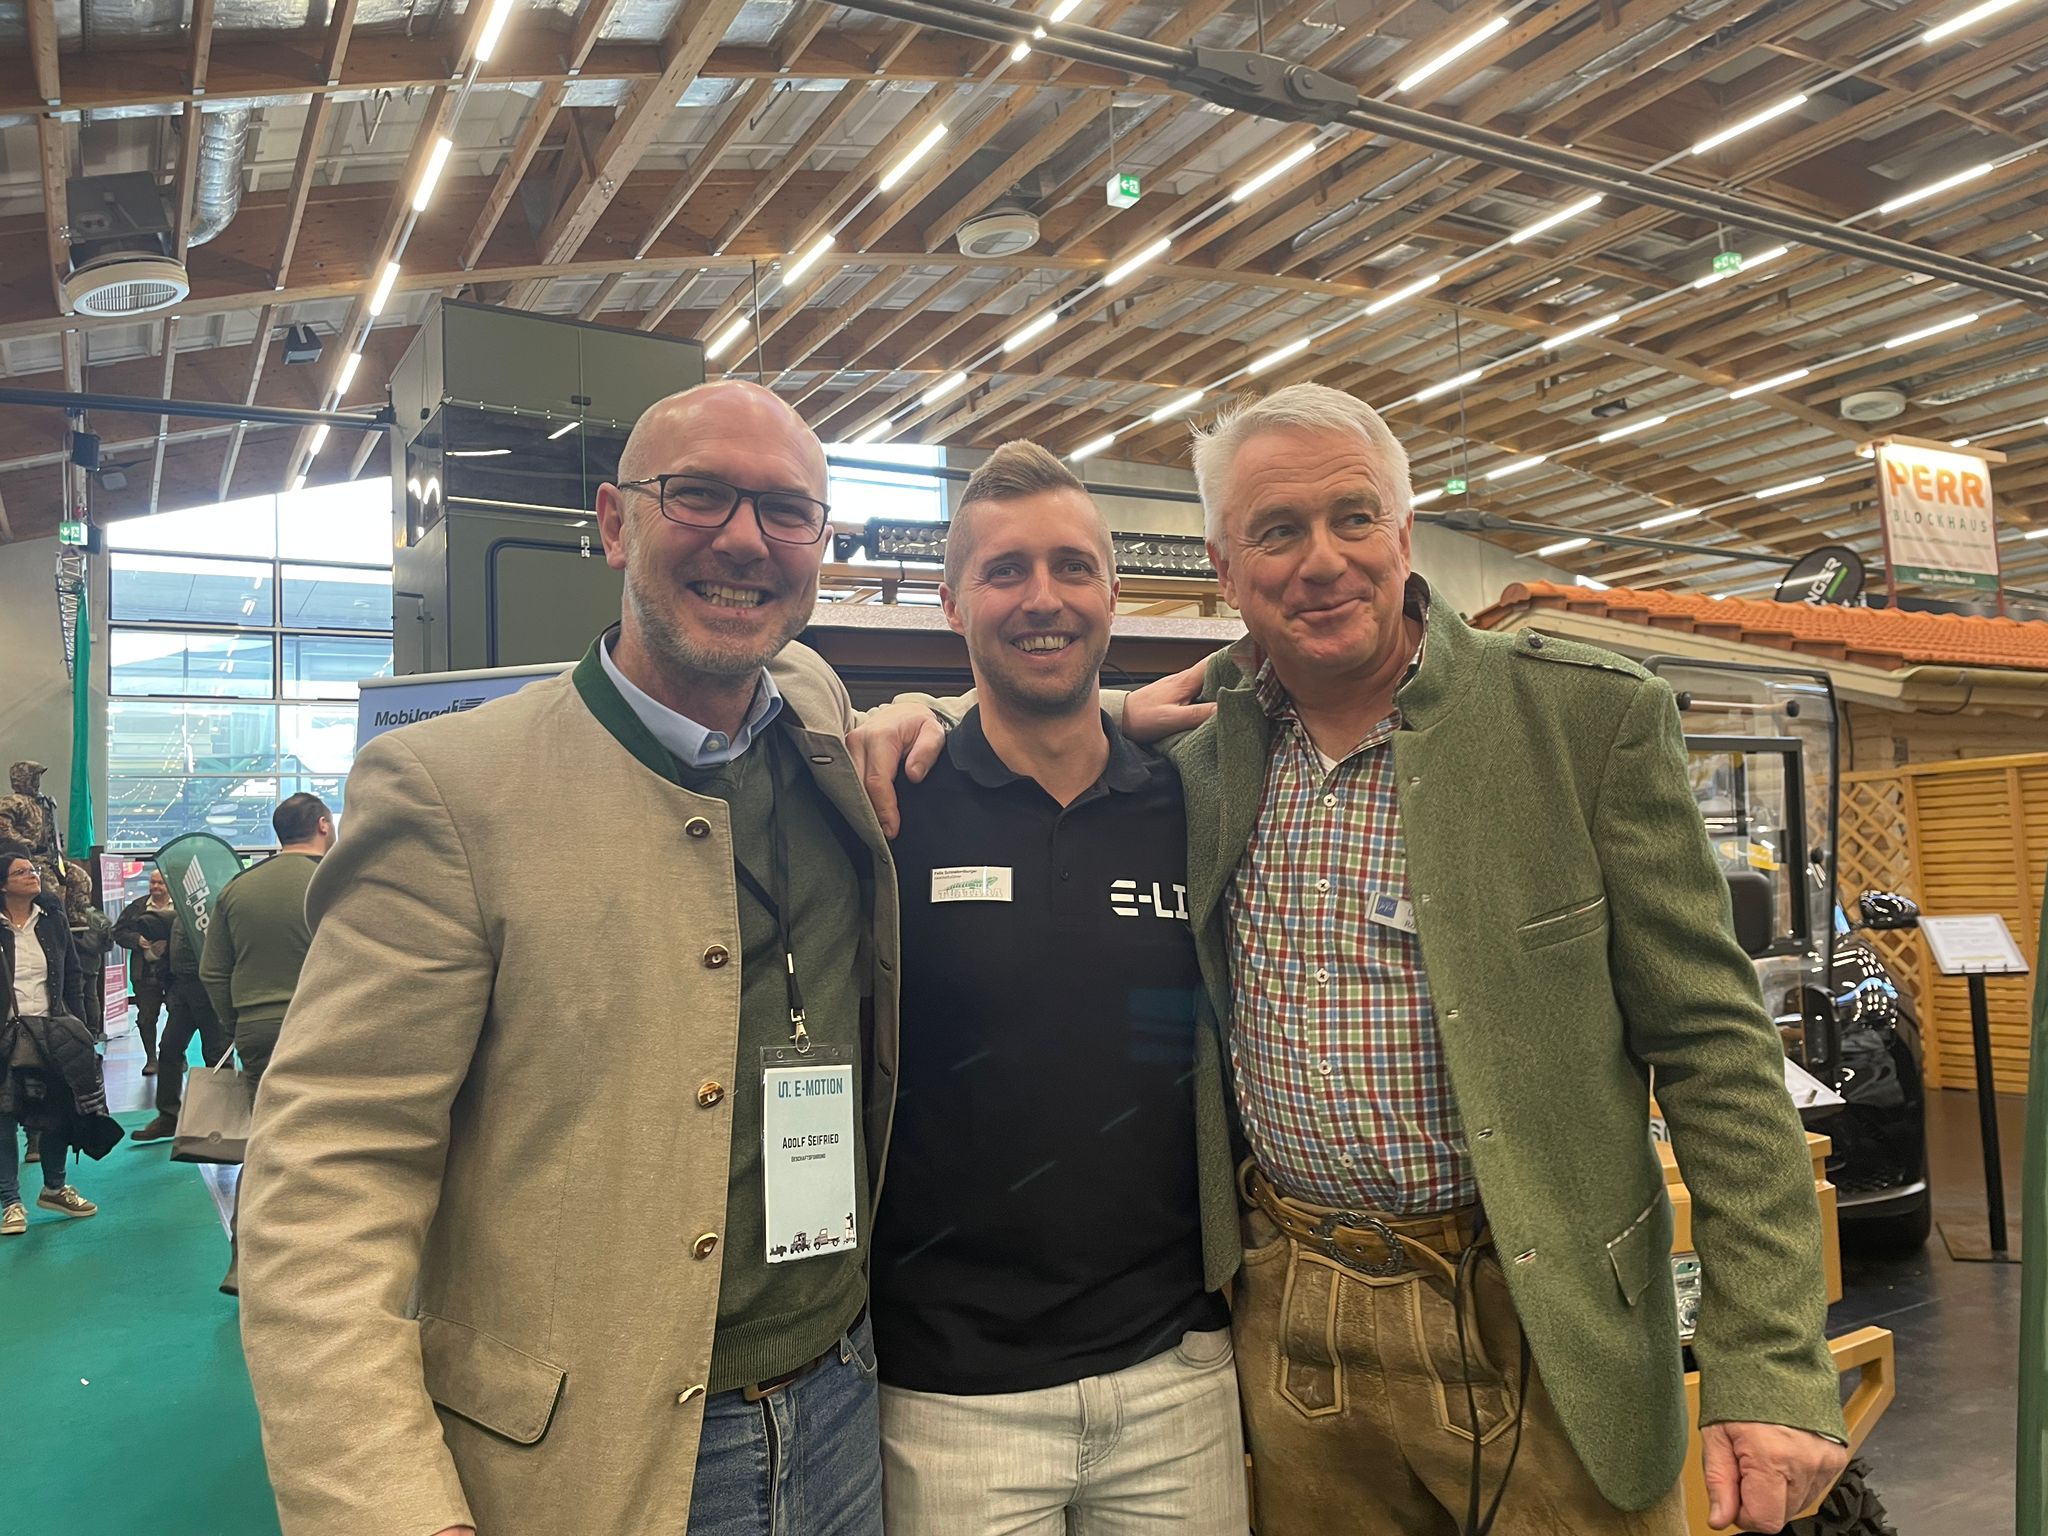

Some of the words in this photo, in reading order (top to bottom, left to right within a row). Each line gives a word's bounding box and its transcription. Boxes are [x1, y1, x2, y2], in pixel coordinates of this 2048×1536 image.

[1886, 460, 1985, 508] PERR
[1892, 509, 1988, 533] BLOCKHAUS
[794, 1078, 843, 1097] E-MOTION
